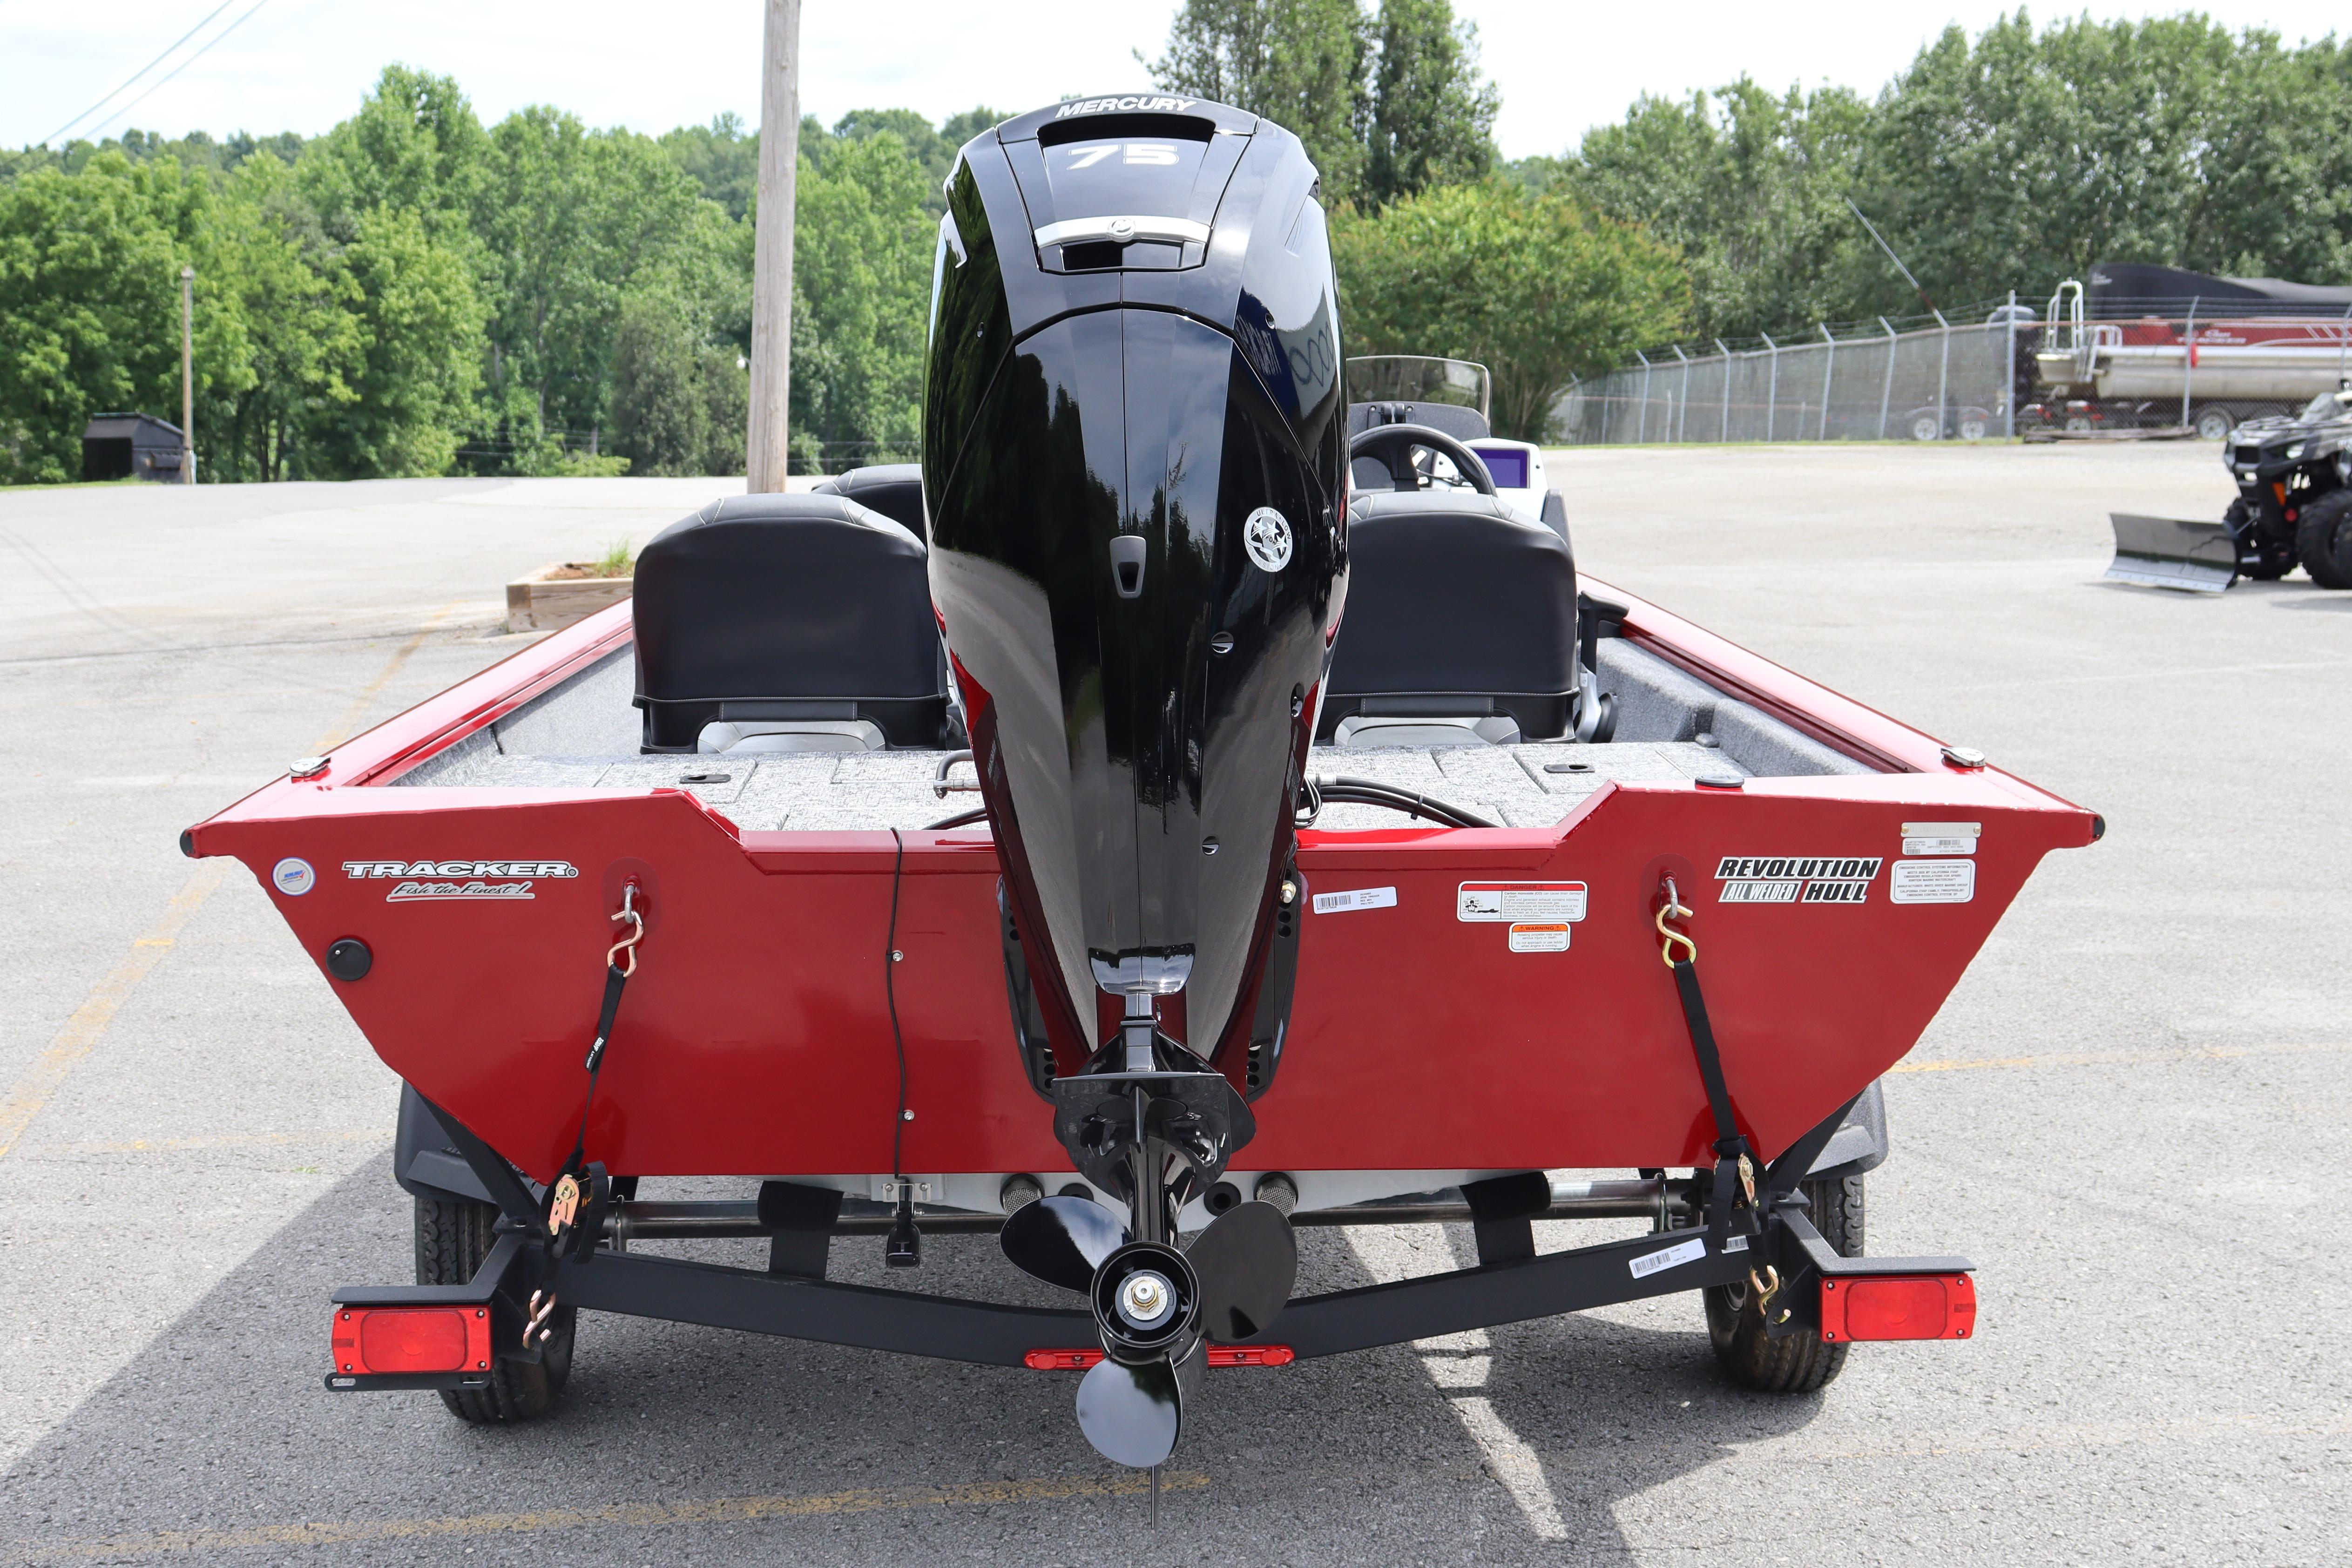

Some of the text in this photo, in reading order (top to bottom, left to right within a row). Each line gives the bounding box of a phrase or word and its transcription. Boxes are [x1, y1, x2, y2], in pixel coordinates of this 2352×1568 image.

[1054, 96, 1197, 118] MERCURY
[1067, 144, 1180, 170] 75
[1256, 509, 1291, 539] ULTRA LOW
[1248, 546, 1278, 570] EMISSION
[1718, 859, 1879, 877] REVOLUTION
[394, 884, 430, 894] Fish
[433, 884, 458, 894] the
[1725, 883, 1867, 901] ALL WELDED HULL
